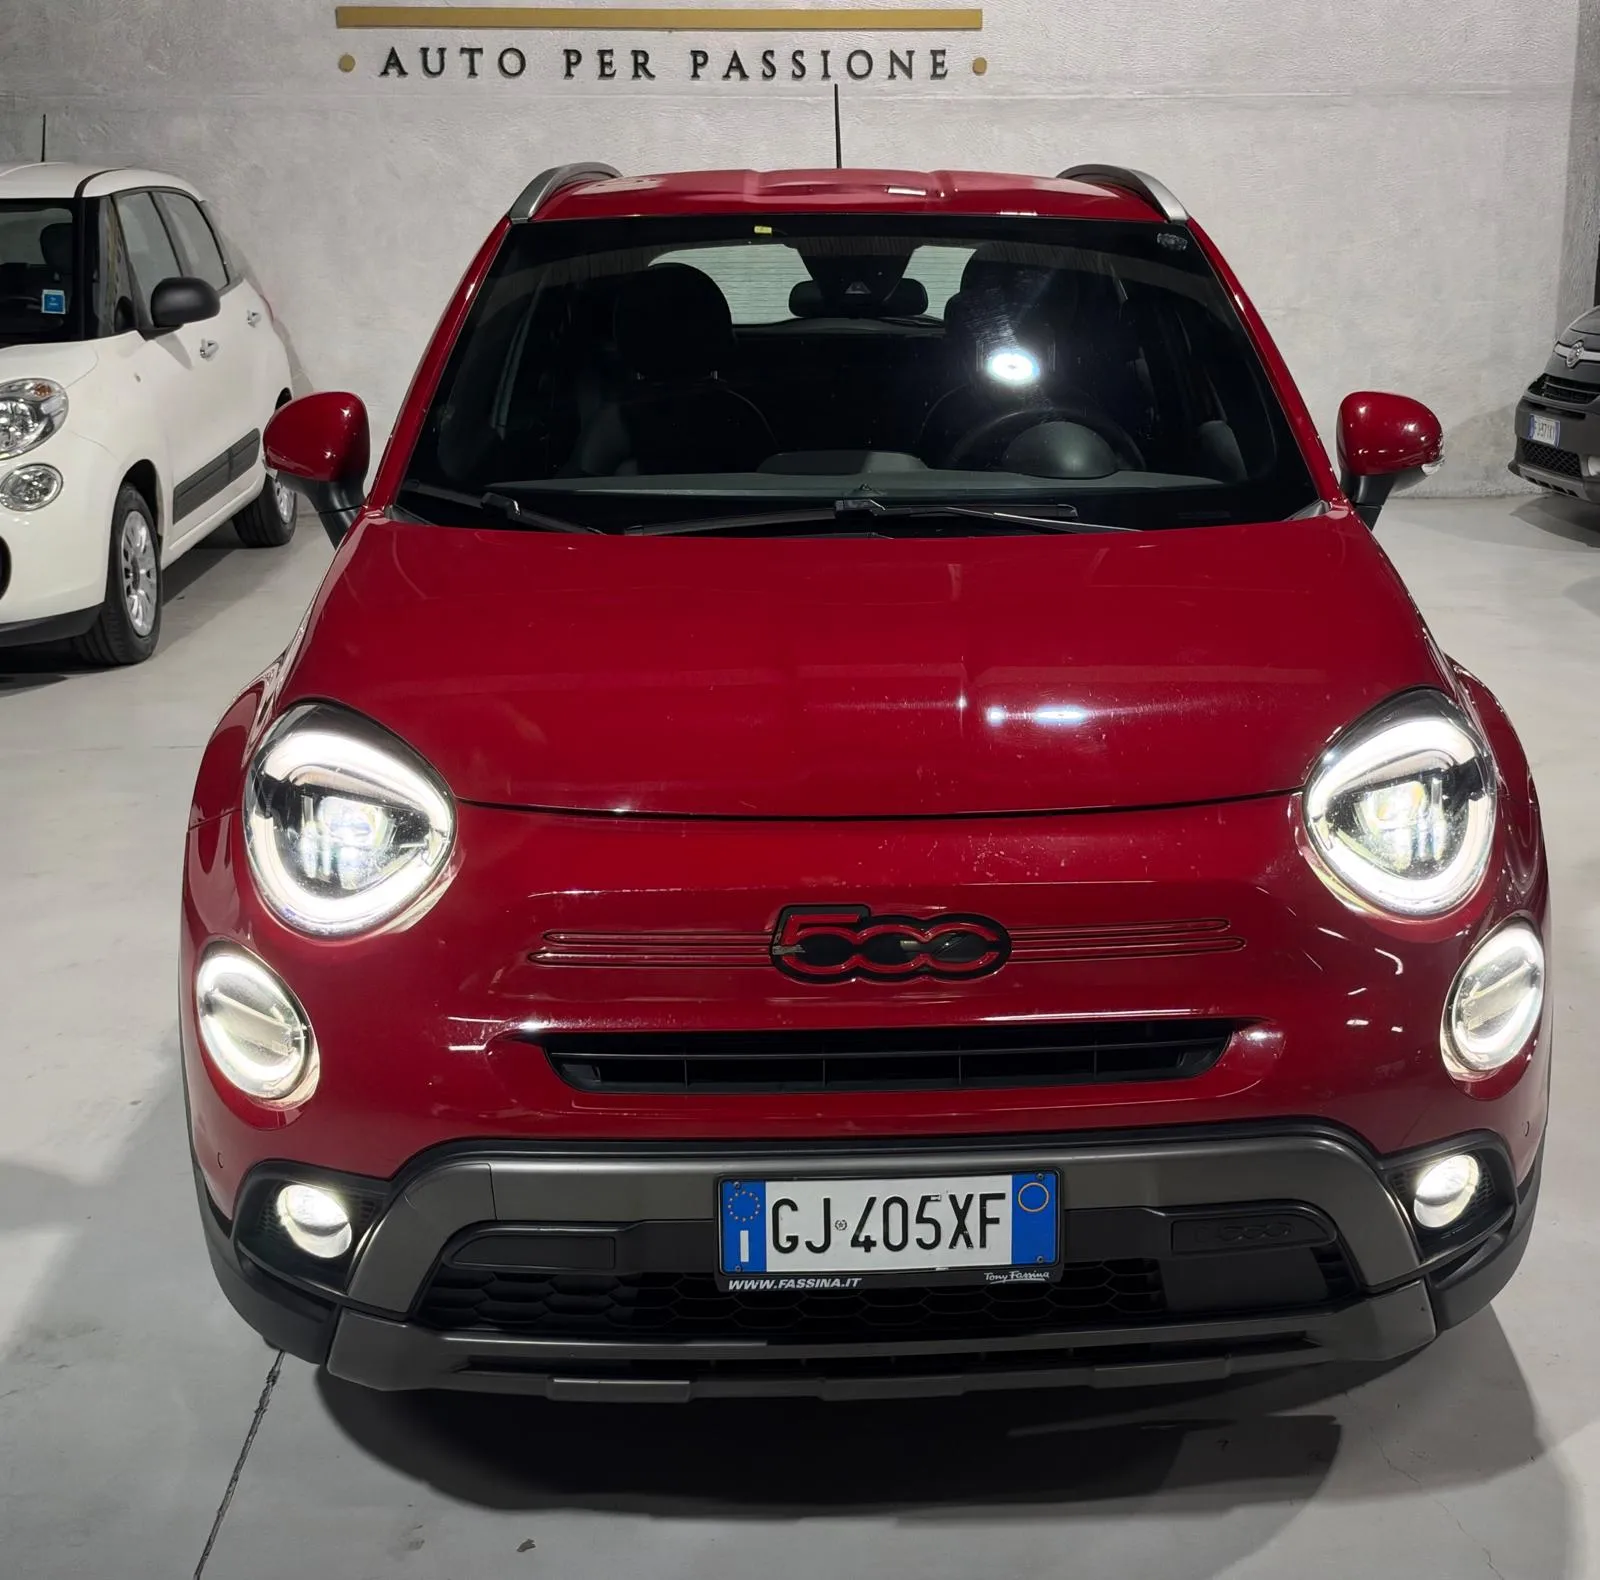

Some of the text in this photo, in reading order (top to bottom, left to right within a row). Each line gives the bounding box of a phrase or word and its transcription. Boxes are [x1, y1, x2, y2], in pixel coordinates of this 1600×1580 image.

[379, 46, 949, 82] AUTO PER PASSIONE
[984, 1270, 1049, 1283] Tony Fassina
[728, 1278, 862, 1290] WWW.FASSINA.IT
